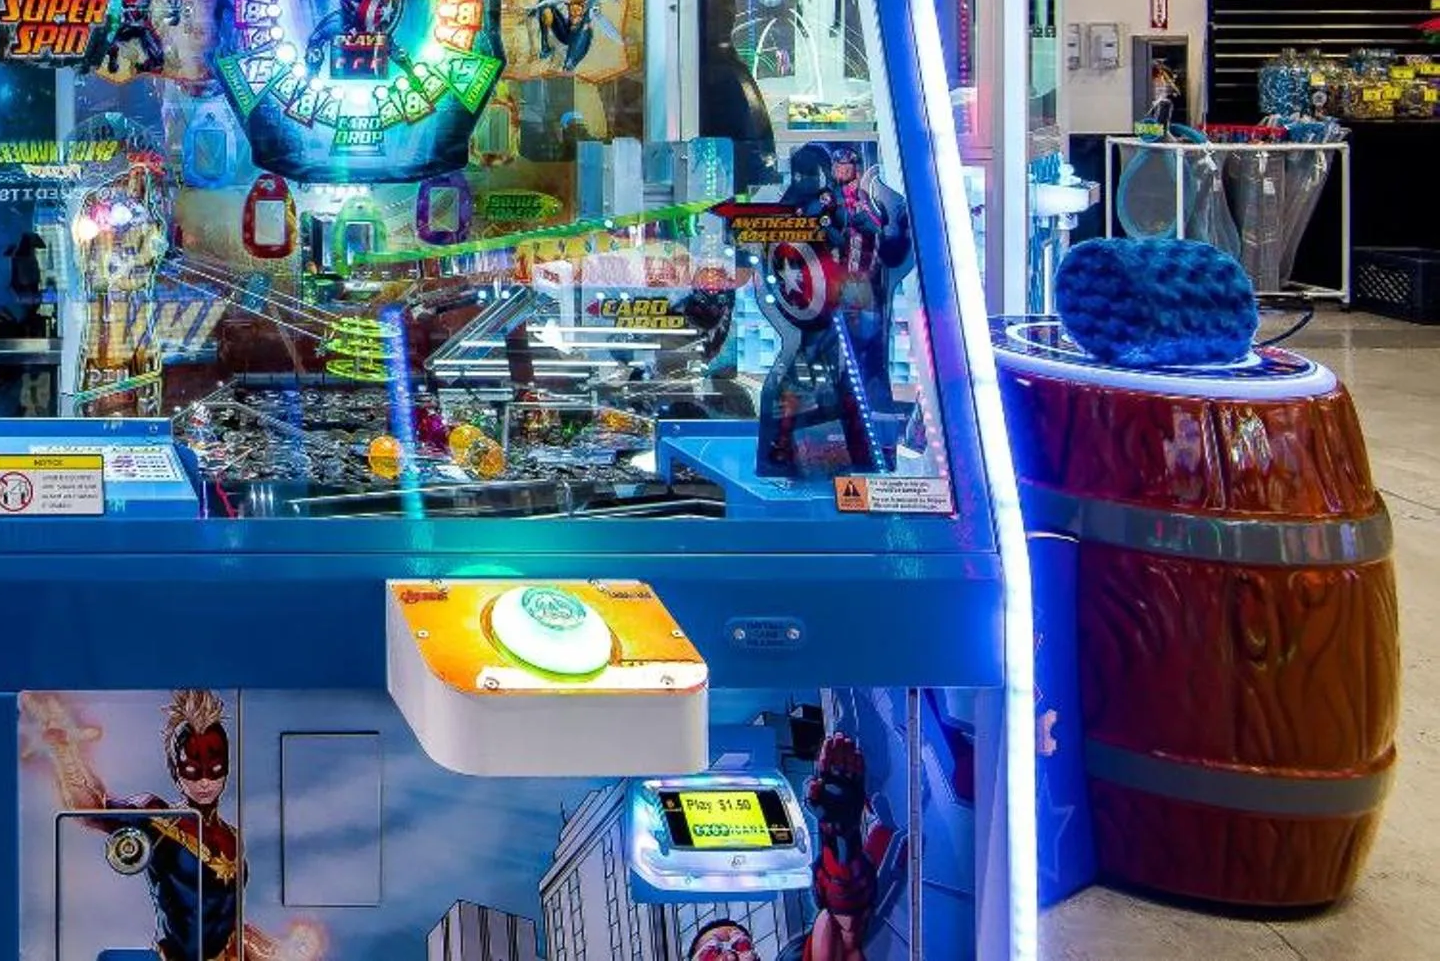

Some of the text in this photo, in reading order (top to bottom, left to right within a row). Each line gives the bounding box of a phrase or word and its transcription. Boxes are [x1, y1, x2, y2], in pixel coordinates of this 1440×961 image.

[13, 23, 90, 56] SPIN
[338, 117, 381, 129] CARD
[334, 131, 384, 144] DROP
[602, 300, 669, 316] CARD
[686, 798, 752, 814] Play $1.50
